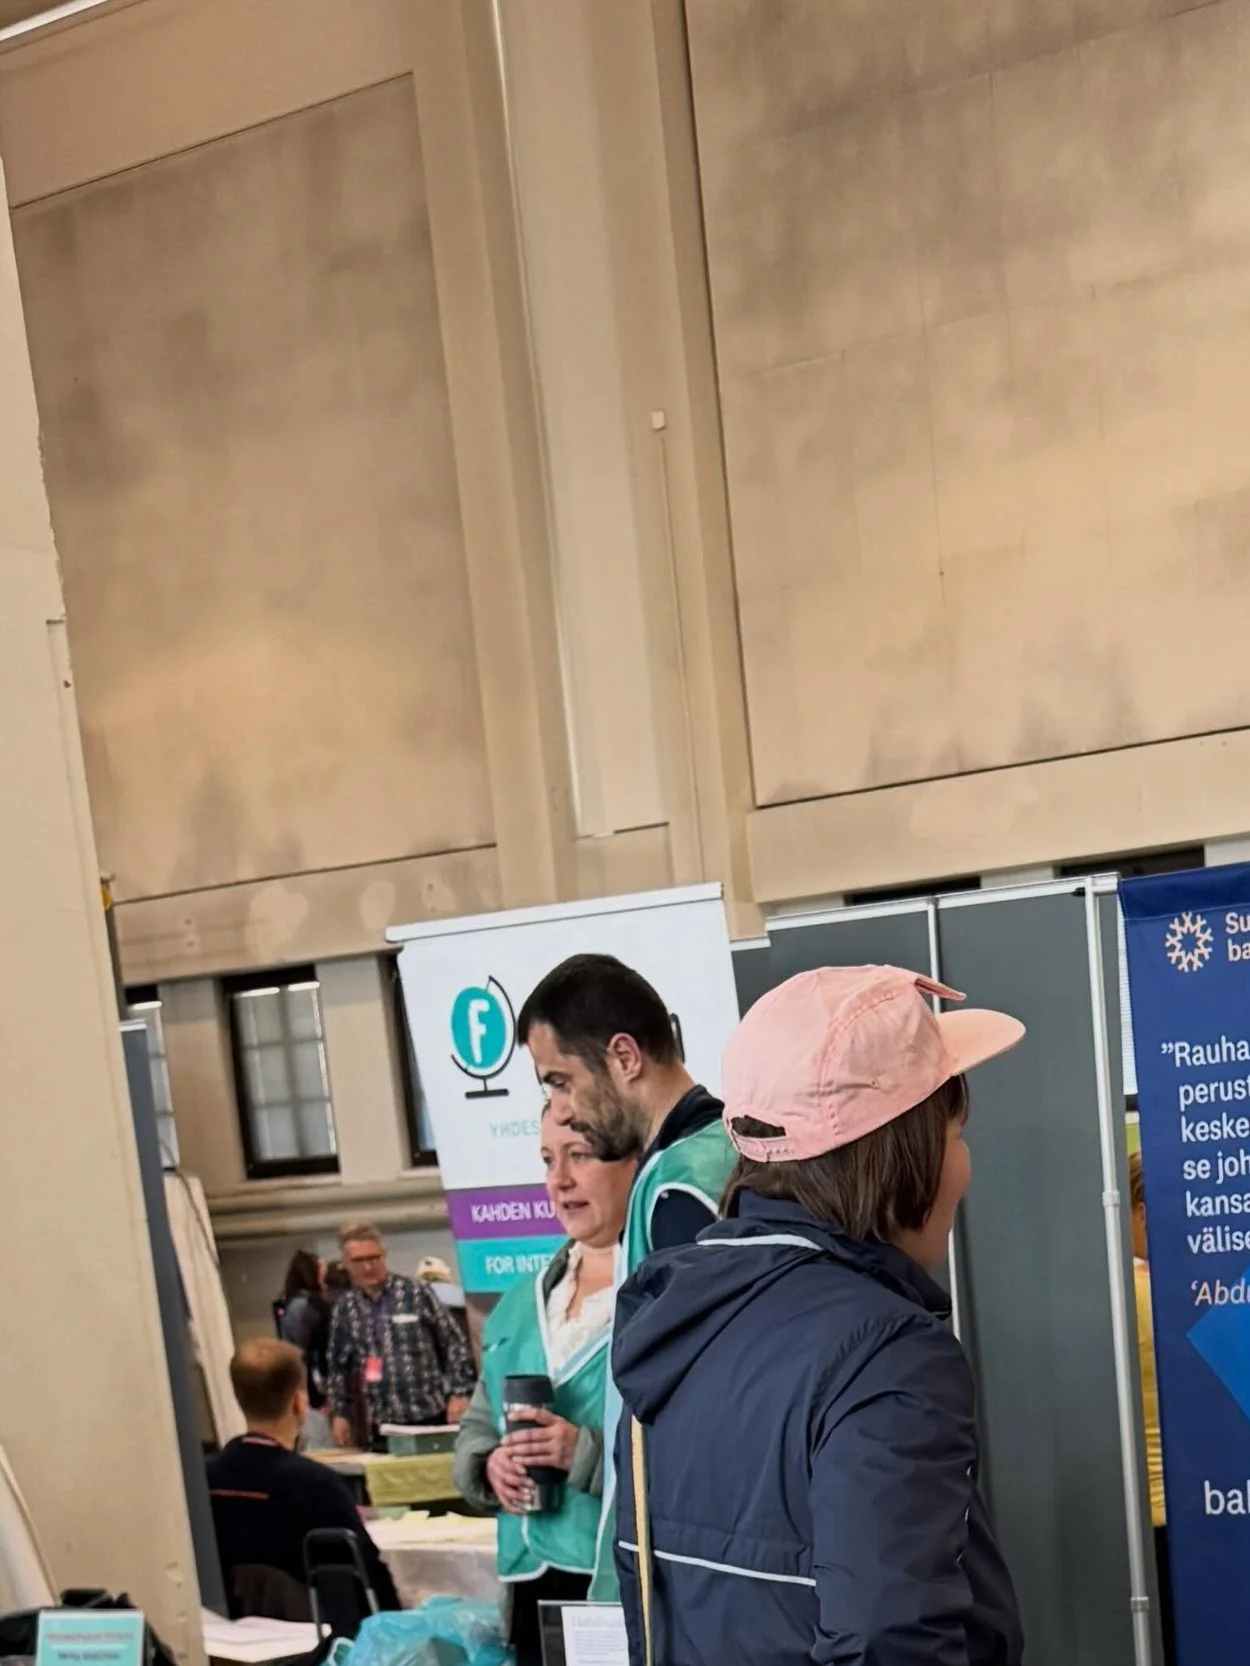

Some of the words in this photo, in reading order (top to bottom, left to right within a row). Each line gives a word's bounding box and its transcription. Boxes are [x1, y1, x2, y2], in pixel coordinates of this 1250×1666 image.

[1183, 1160, 1211, 1181] se
[470, 1200, 532, 1224] KAHDEN
[484, 1255, 516, 1274] FOR
